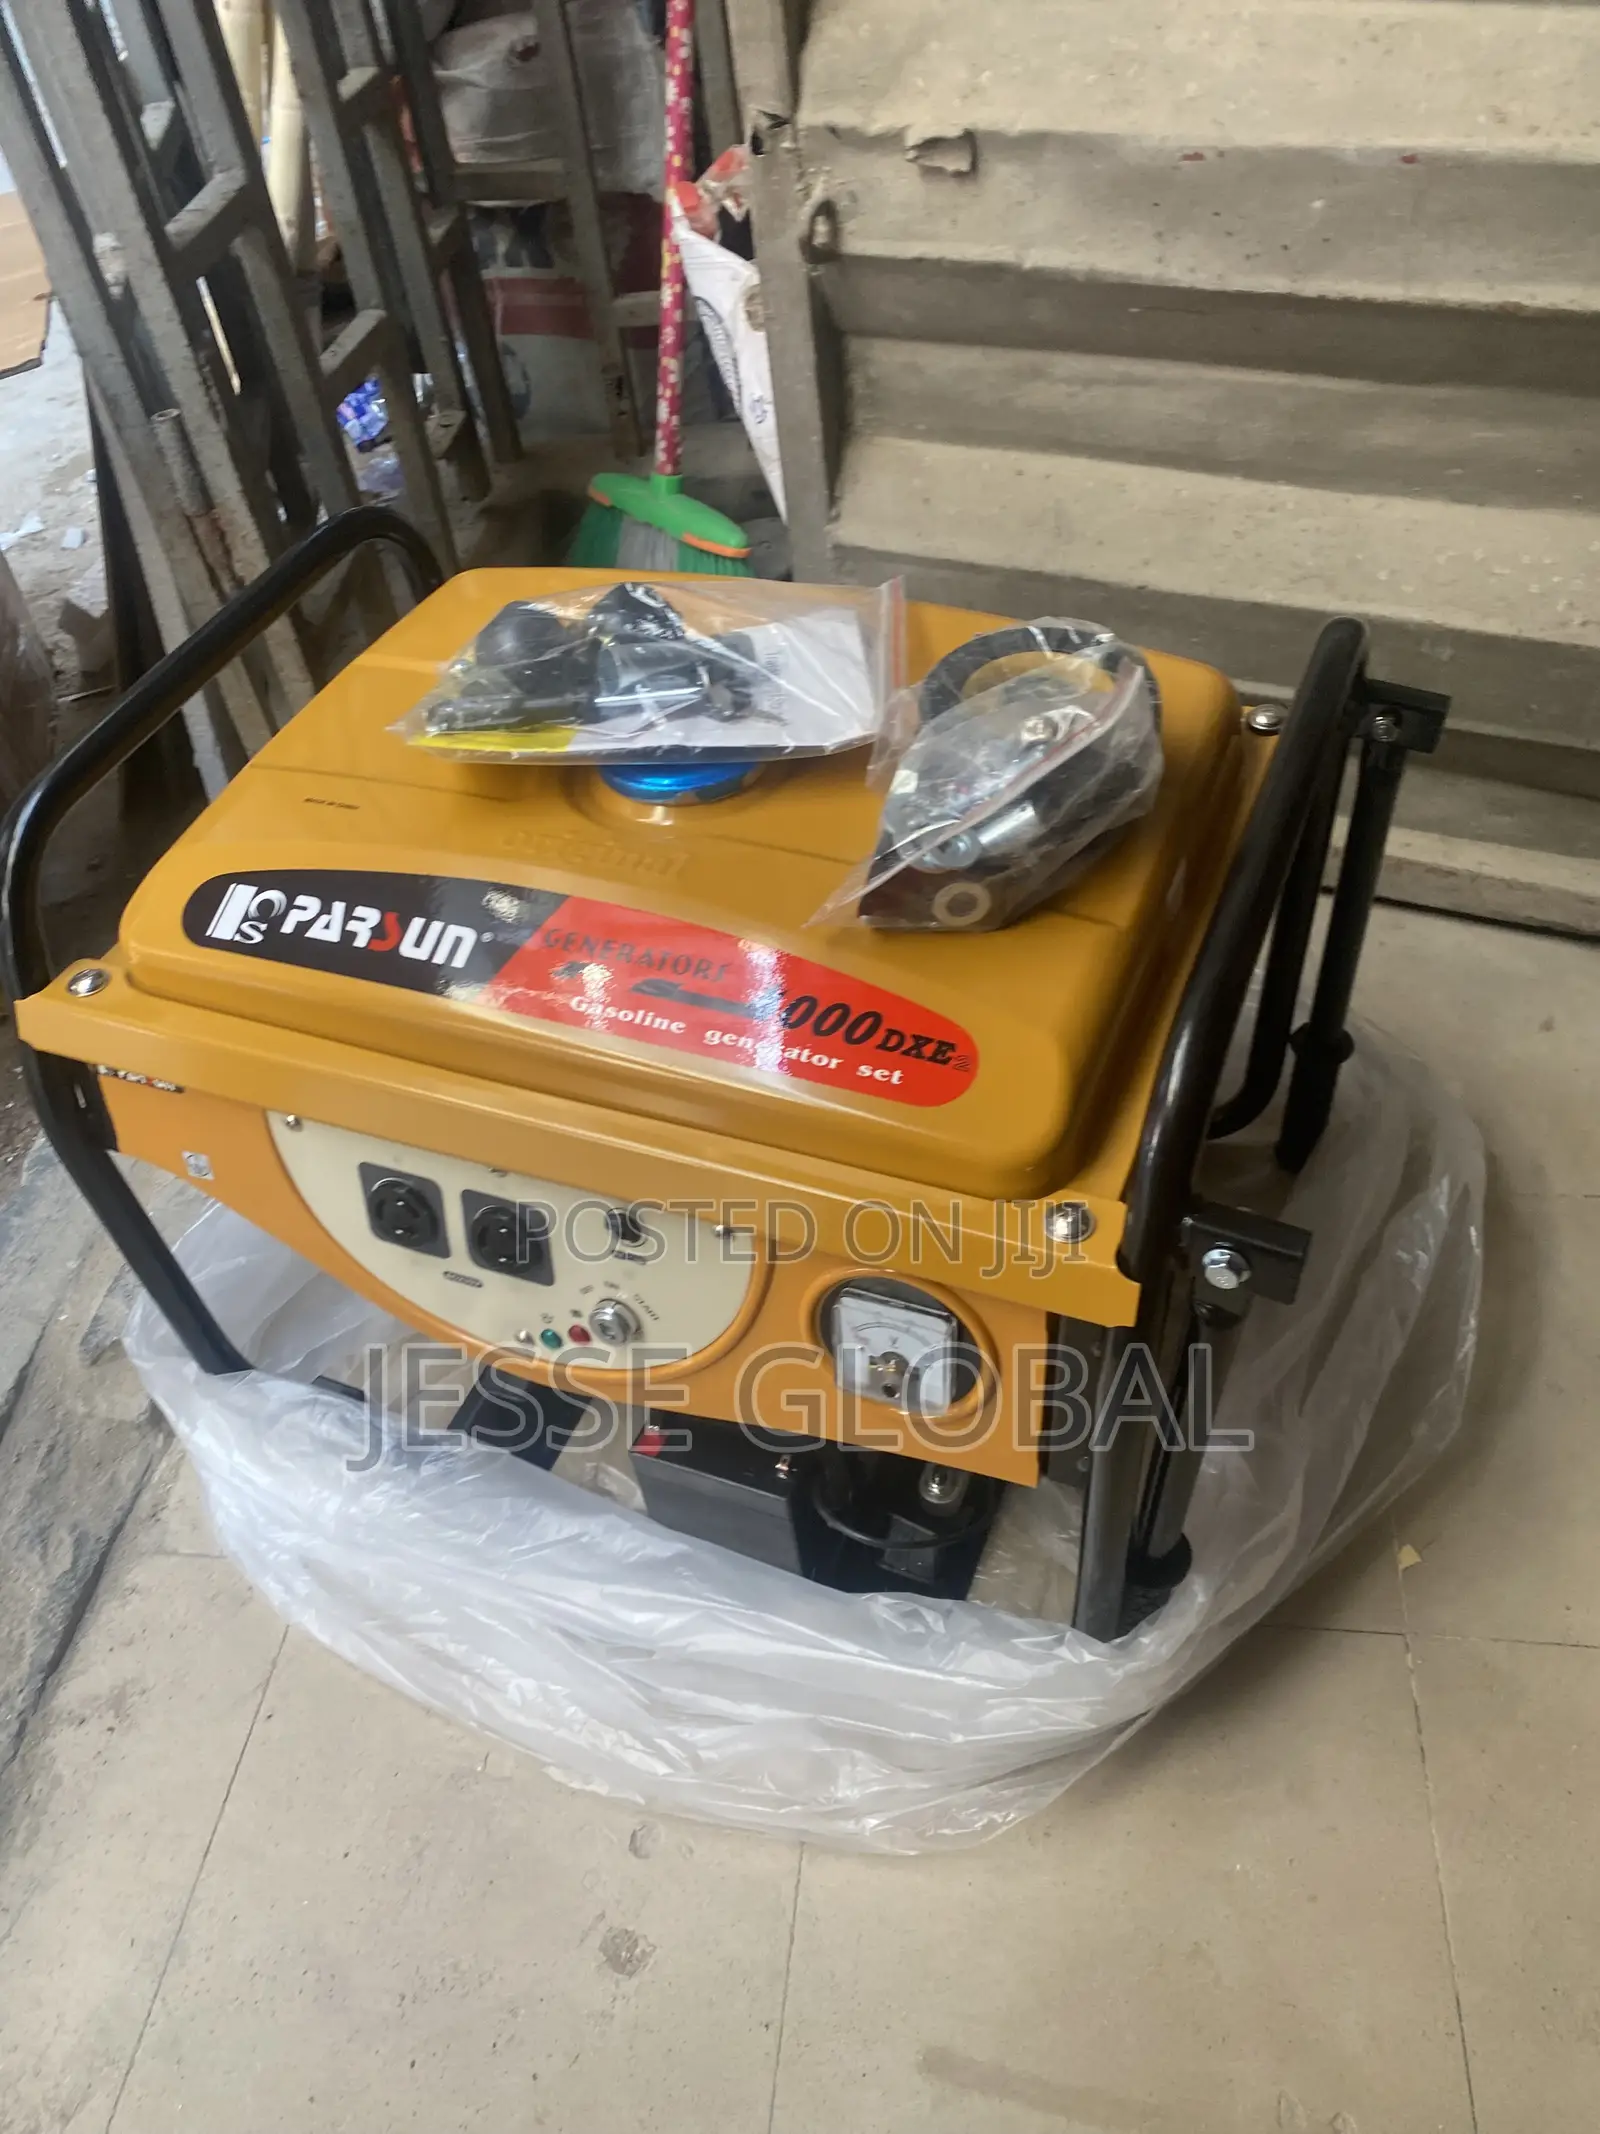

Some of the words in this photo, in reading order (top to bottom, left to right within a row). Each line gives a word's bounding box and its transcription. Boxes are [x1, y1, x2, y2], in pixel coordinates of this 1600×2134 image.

[544, 927, 731, 984] GENERATORS
[569, 995, 687, 1034] Gasoline
[702, 1028, 844, 1070] genator
[855, 1064, 904, 1085] set
